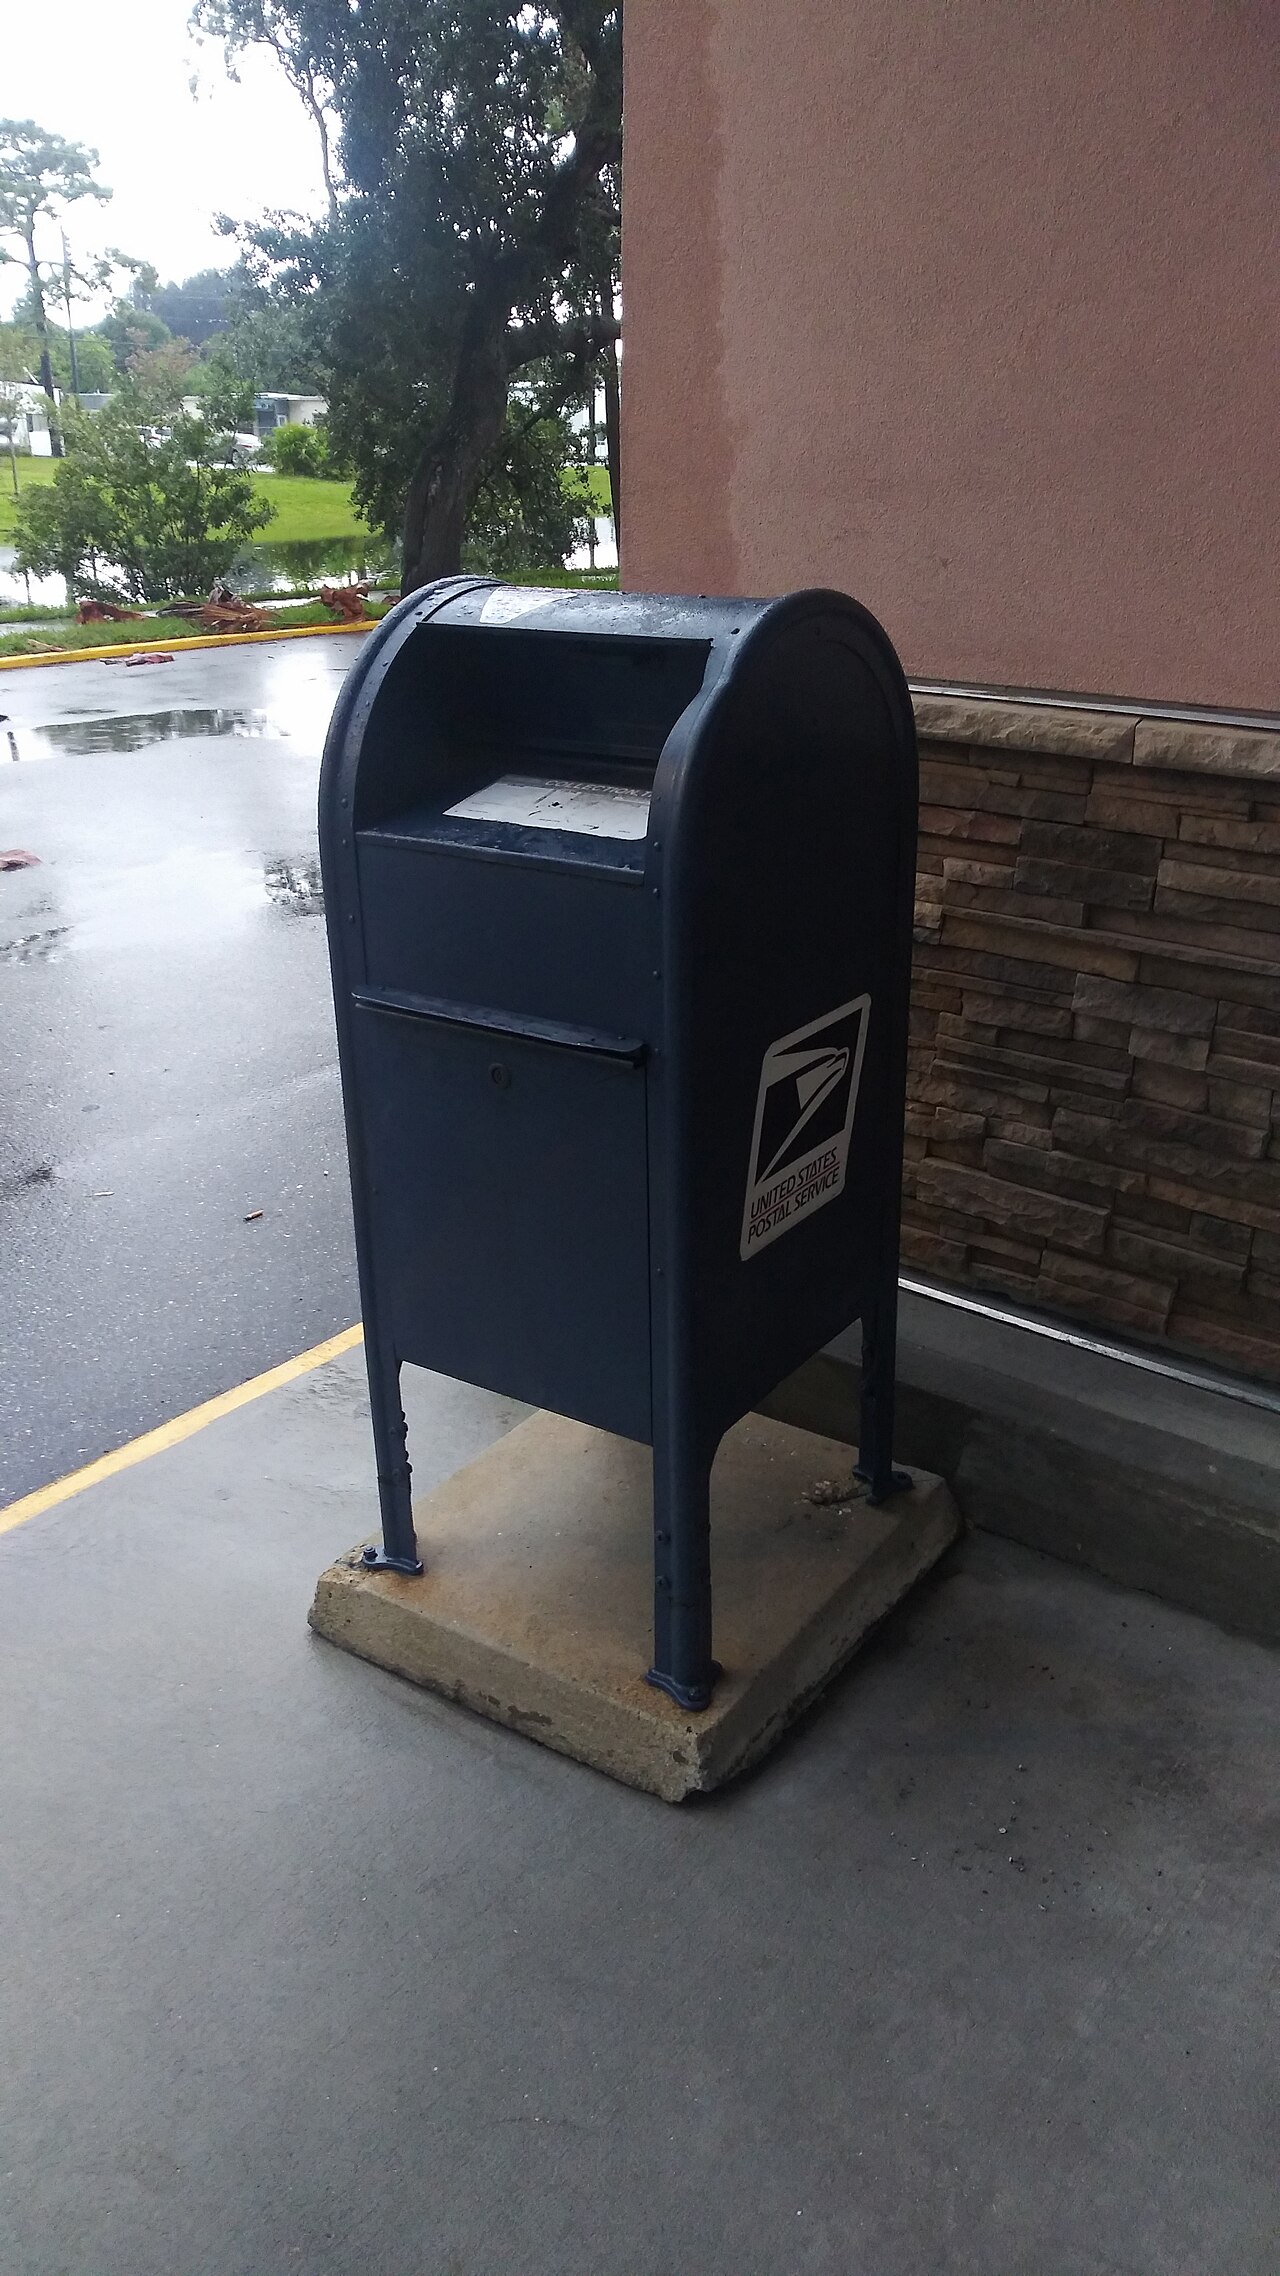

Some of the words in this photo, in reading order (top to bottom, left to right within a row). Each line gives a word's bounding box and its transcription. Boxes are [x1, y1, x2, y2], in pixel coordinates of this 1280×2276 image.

[545, 780, 640, 796] COLLECTION
[748, 1201, 791, 1244] POSTAL
[794, 1167, 840, 1211] SERVICE
[751, 1175, 795, 1218] UNITED
[797, 1147, 837, 1187] STATES
